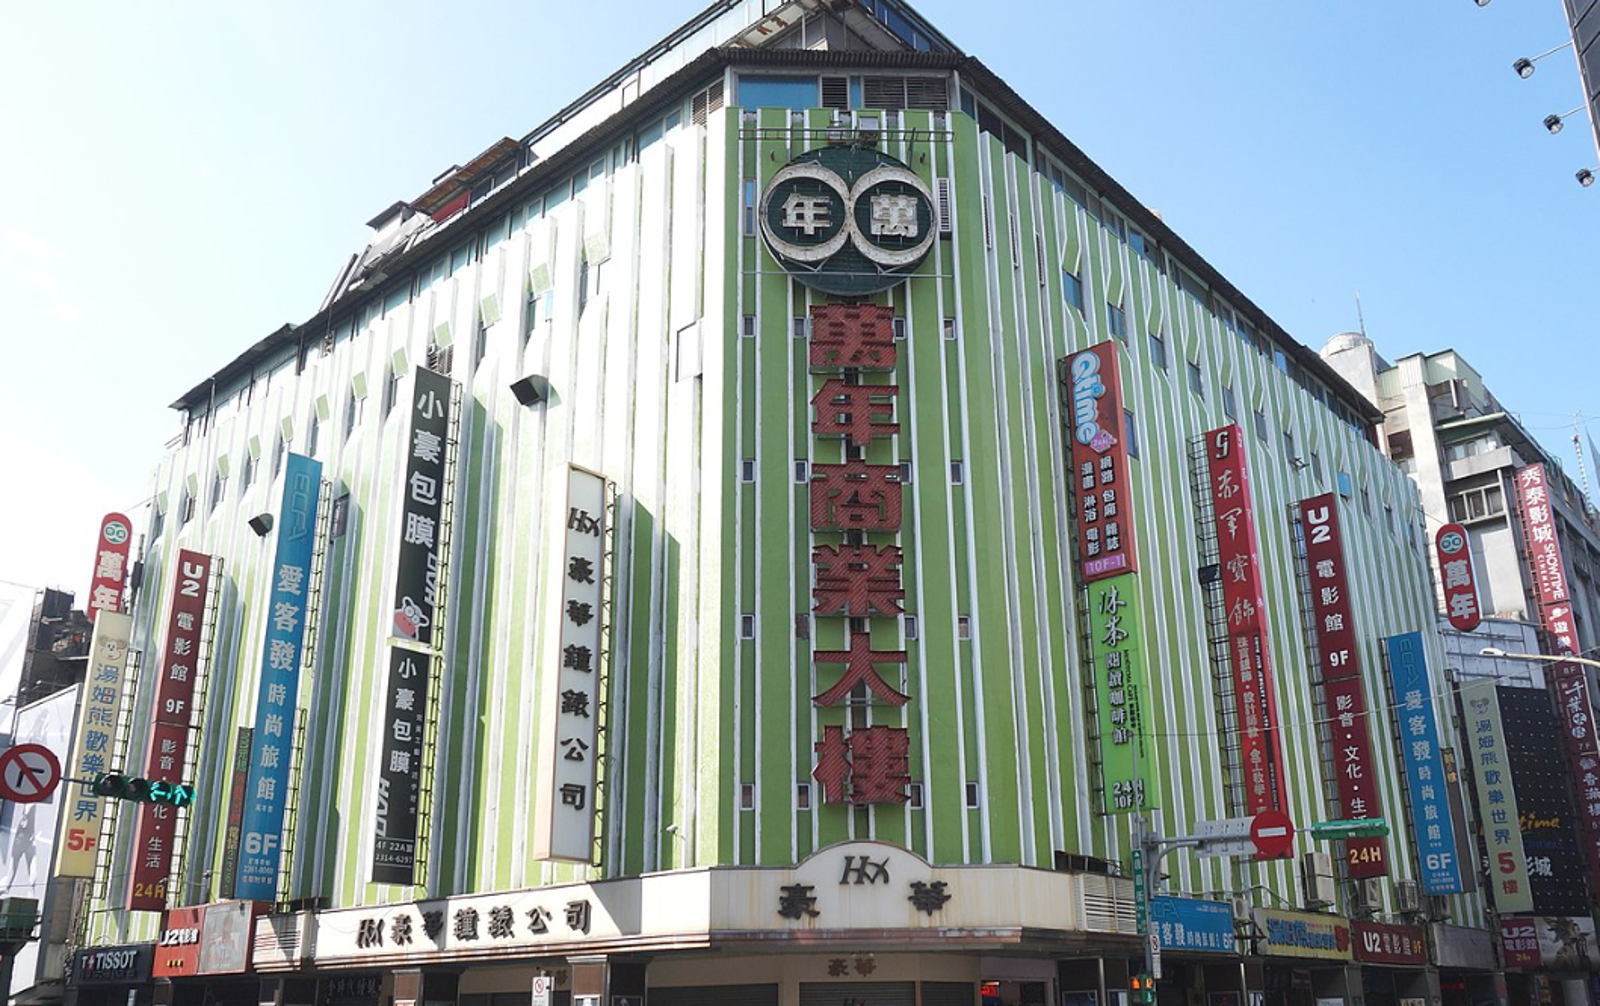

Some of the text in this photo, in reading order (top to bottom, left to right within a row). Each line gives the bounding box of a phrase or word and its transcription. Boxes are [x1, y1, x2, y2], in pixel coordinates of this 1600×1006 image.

[405, 390, 444, 548] 小豪包膜
[1522, 466, 1553, 543] 秀泰影城
[1307, 506, 1331, 544] U2
[809, 303, 912, 804] 萬年商業大樓
[1089, 555, 1124, 574] 10F-1
[1544, 543, 1565, 599] SHOWTIME
[90, 550, 125, 611] 萬年
[181, 561, 203, 597] U2
[1443, 561, 1477, 619] 萬年
[1537, 554, 1551, 592] CINEMAS
[1316, 559, 1343, 631] 電影館
[170, 611, 194, 682] 電影館
[1330, 650, 1348, 667] 9F
[559, 556, 595, 810] 豪華鐘錶公司
[166, 699, 185, 714] 9F
[389, 658, 417, 774] 小豪包膜
[74, 663, 120, 822] 湯姆熊歡樂世界
[1405, 689, 1443, 841] 愛客發時尚旅館
[1475, 719, 1511, 845] 湯姆熊歡樂世界
[67, 828, 96, 851] 5F
[245, 832, 278, 855] 6F
[1350, 847, 1382, 864] 24H
[1425, 853, 1452, 870] 6F
[134, 882, 165, 899] 24H
[1363, 931, 1381, 953] U2
[1501, 926, 1535, 938] U2
[1504, 938, 1538, 951] 電影館
[96, 951, 136, 969] TISSOT
[828, 957, 877, 977] 豪華
